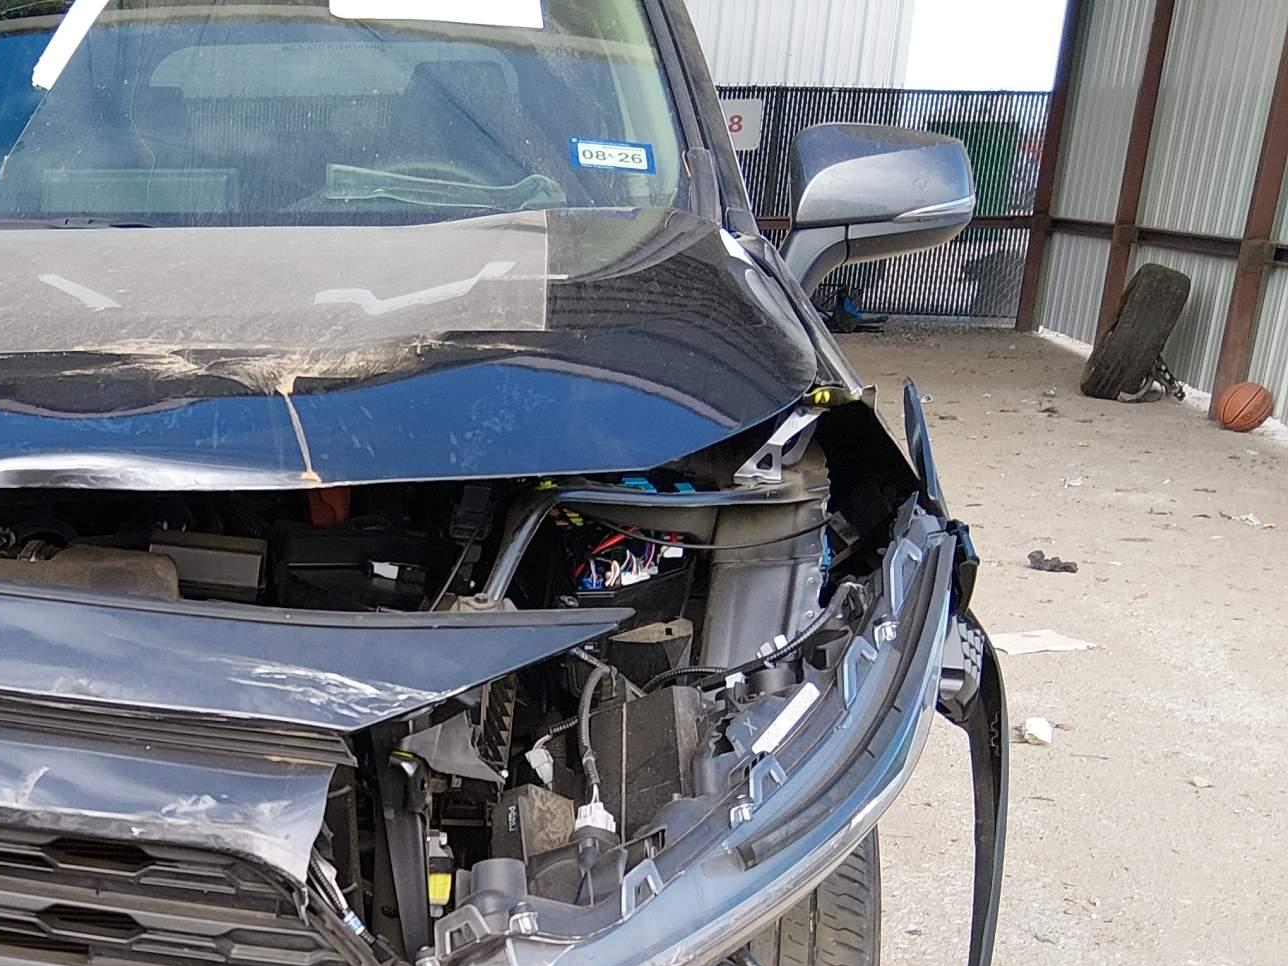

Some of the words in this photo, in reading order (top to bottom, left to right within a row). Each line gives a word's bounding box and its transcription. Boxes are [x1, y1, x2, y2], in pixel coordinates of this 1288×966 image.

[728, 115, 743, 132] 8
[582, 149, 606, 161] 08
[618, 152, 643, 164] 26
